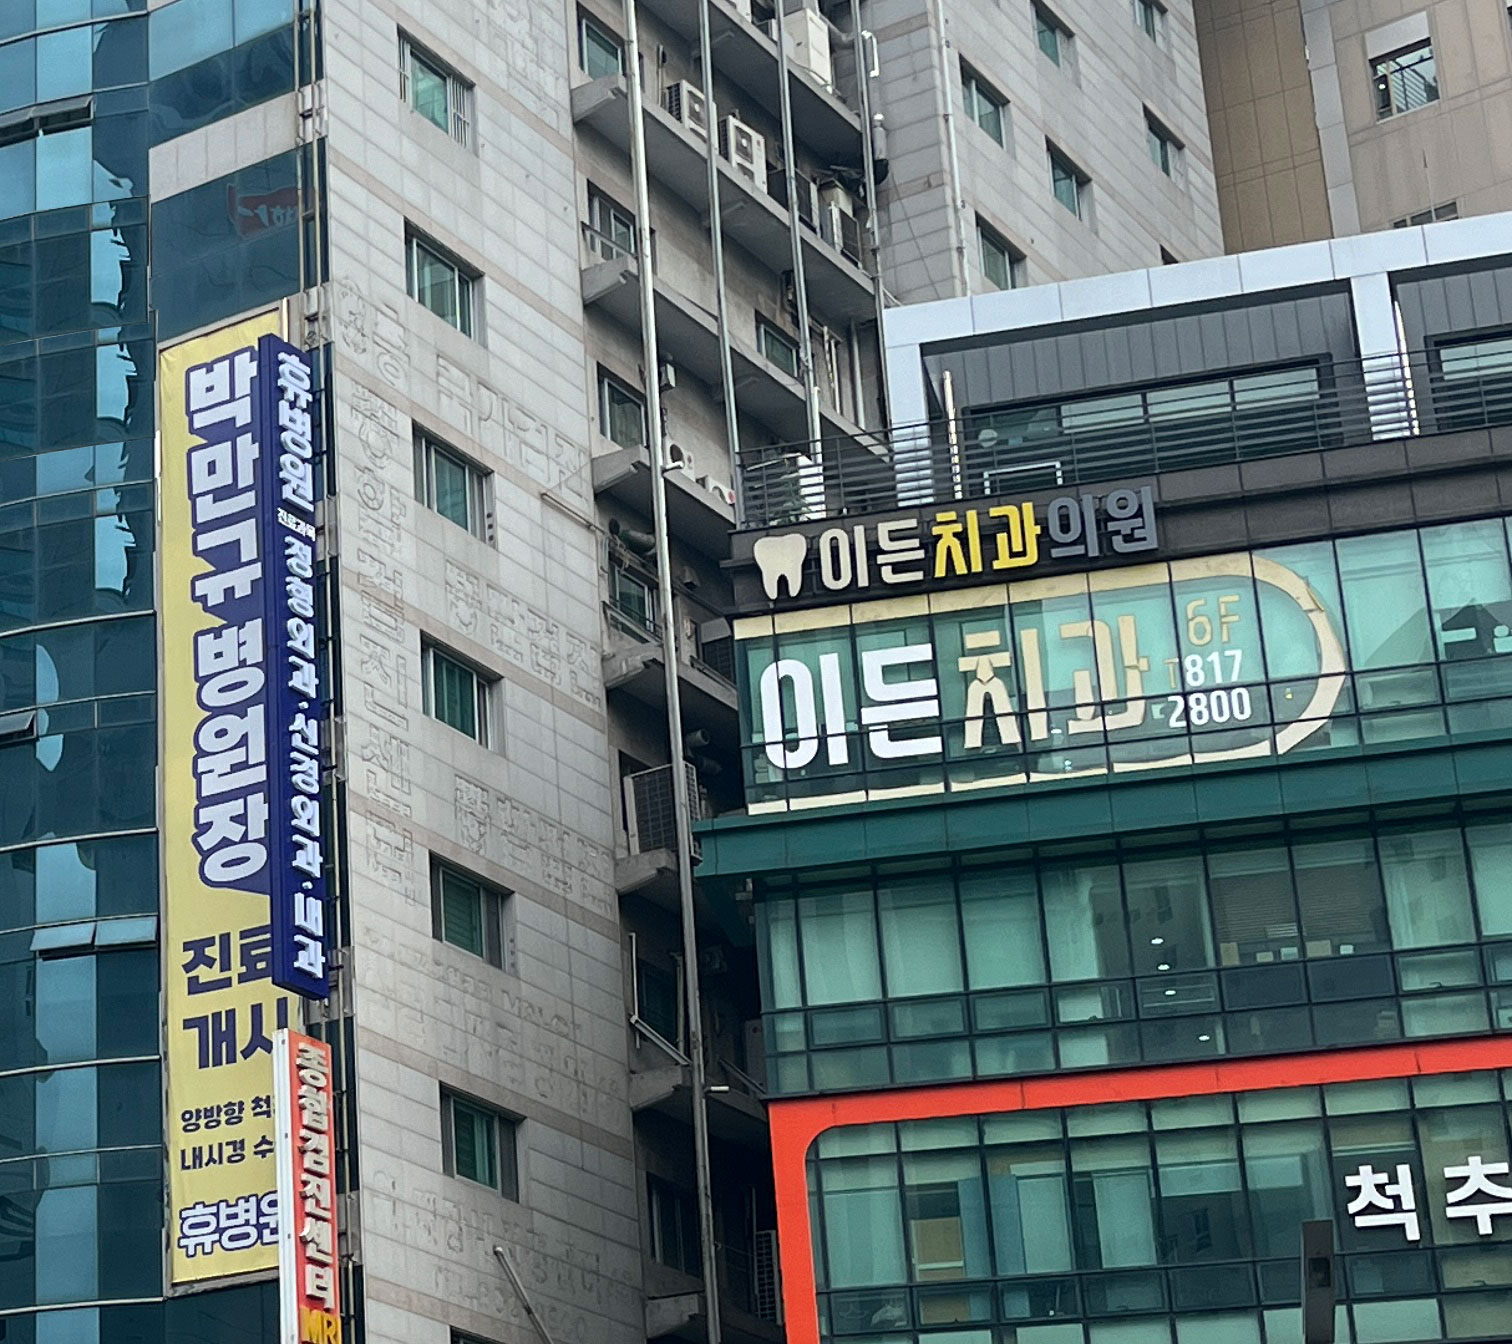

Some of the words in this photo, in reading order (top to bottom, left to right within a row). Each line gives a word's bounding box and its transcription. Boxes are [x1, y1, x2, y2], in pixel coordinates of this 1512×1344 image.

[189, 352, 262, 607] 박만규
[278, 351, 315, 513] 휴병원
[819, 486, 1157, 591] 이든치과의원
[1186, 595, 1240, 647] 6F
[196, 618, 269, 884] 병원장
[759, 615, 1150, 770] 이든치과
[1167, 687, 1252, 728] 2800
[180, 1139, 246, 1172] 내시경
[181, 1101, 245, 1134] 양방향
[296, 1041, 336, 1312] 종합검진센터
